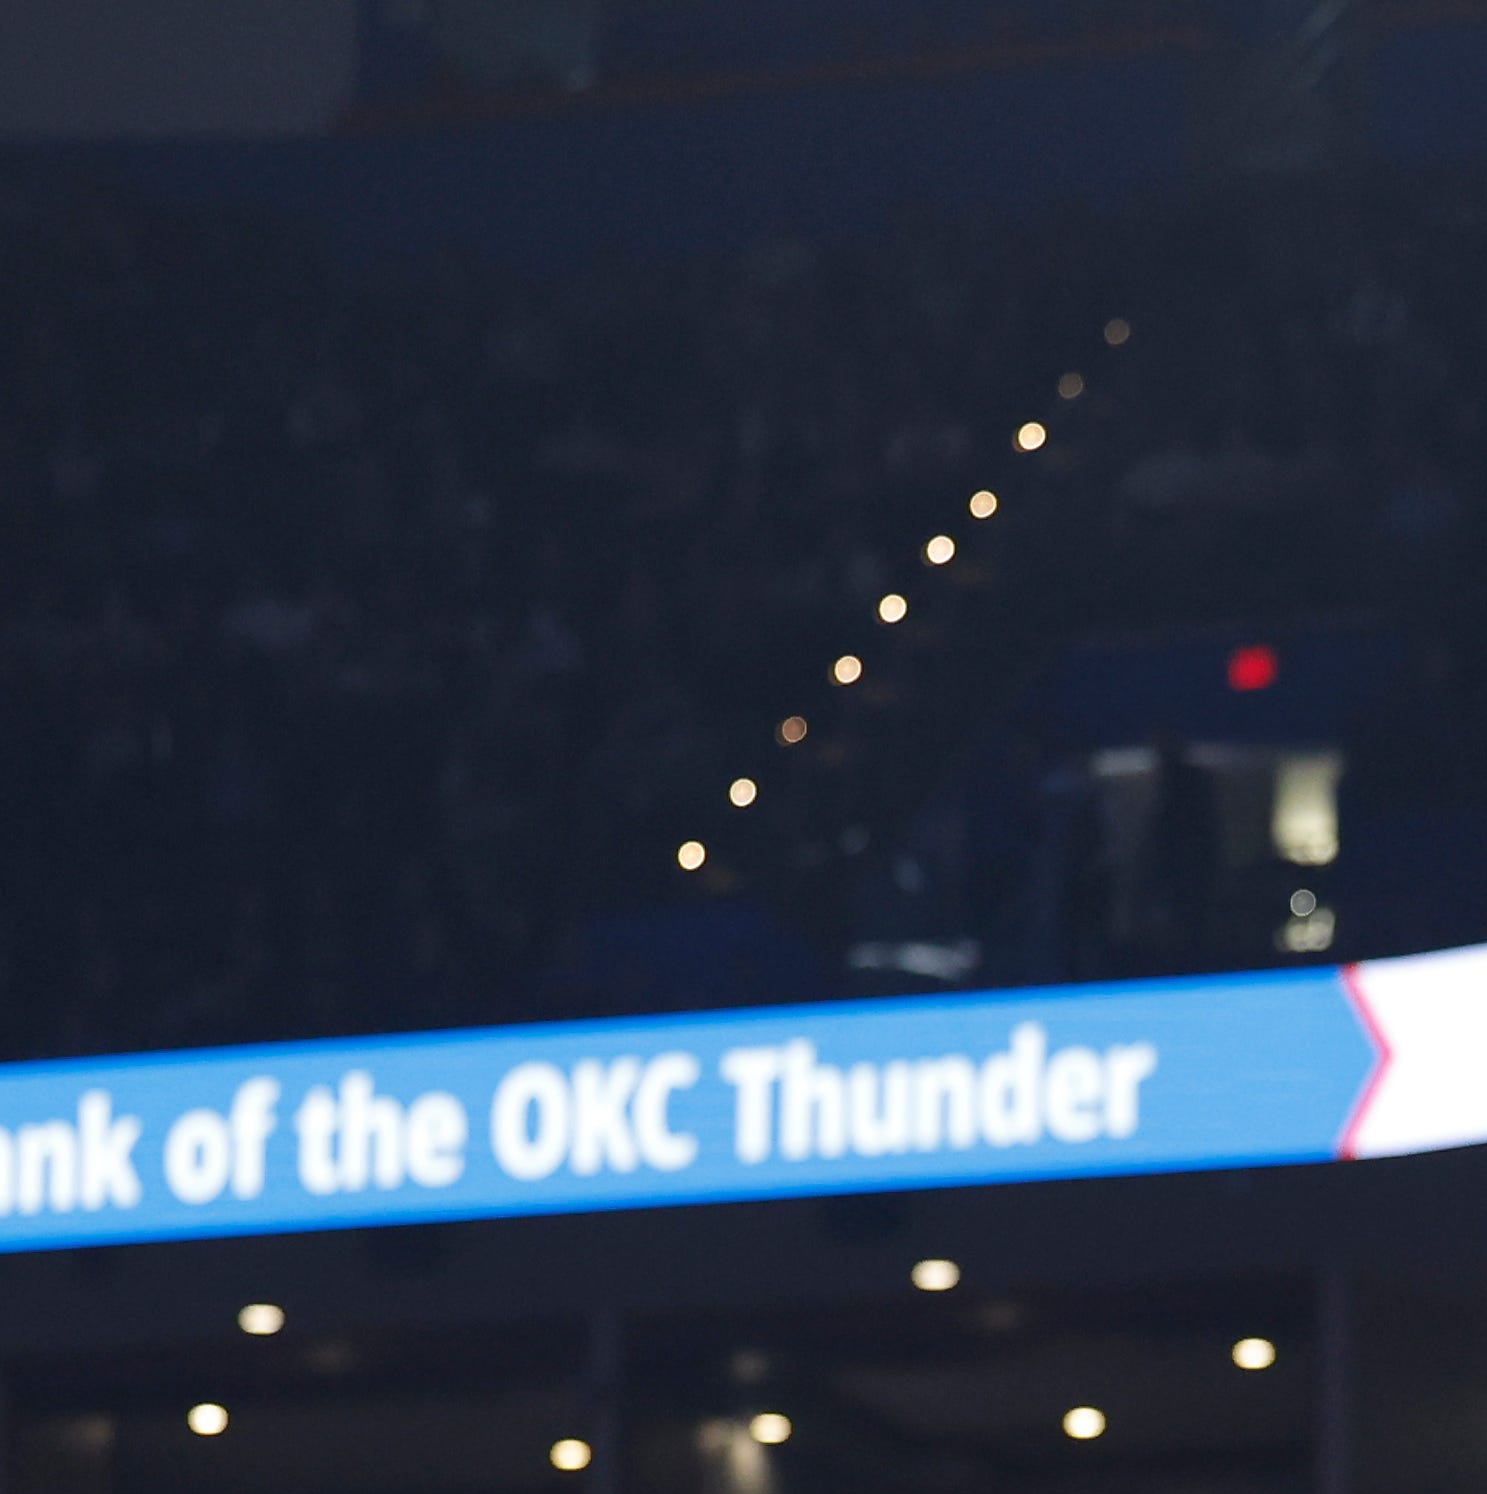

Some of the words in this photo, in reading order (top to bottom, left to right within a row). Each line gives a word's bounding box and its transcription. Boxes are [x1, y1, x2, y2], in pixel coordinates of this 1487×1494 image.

[0, 1088, 143, 1218] nk
[163, 1075, 282, 1206] of
[296, 1068, 469, 1195] the
[489, 1051, 699, 1181] OKC
[720, 1019, 1159, 1166] Thunder
